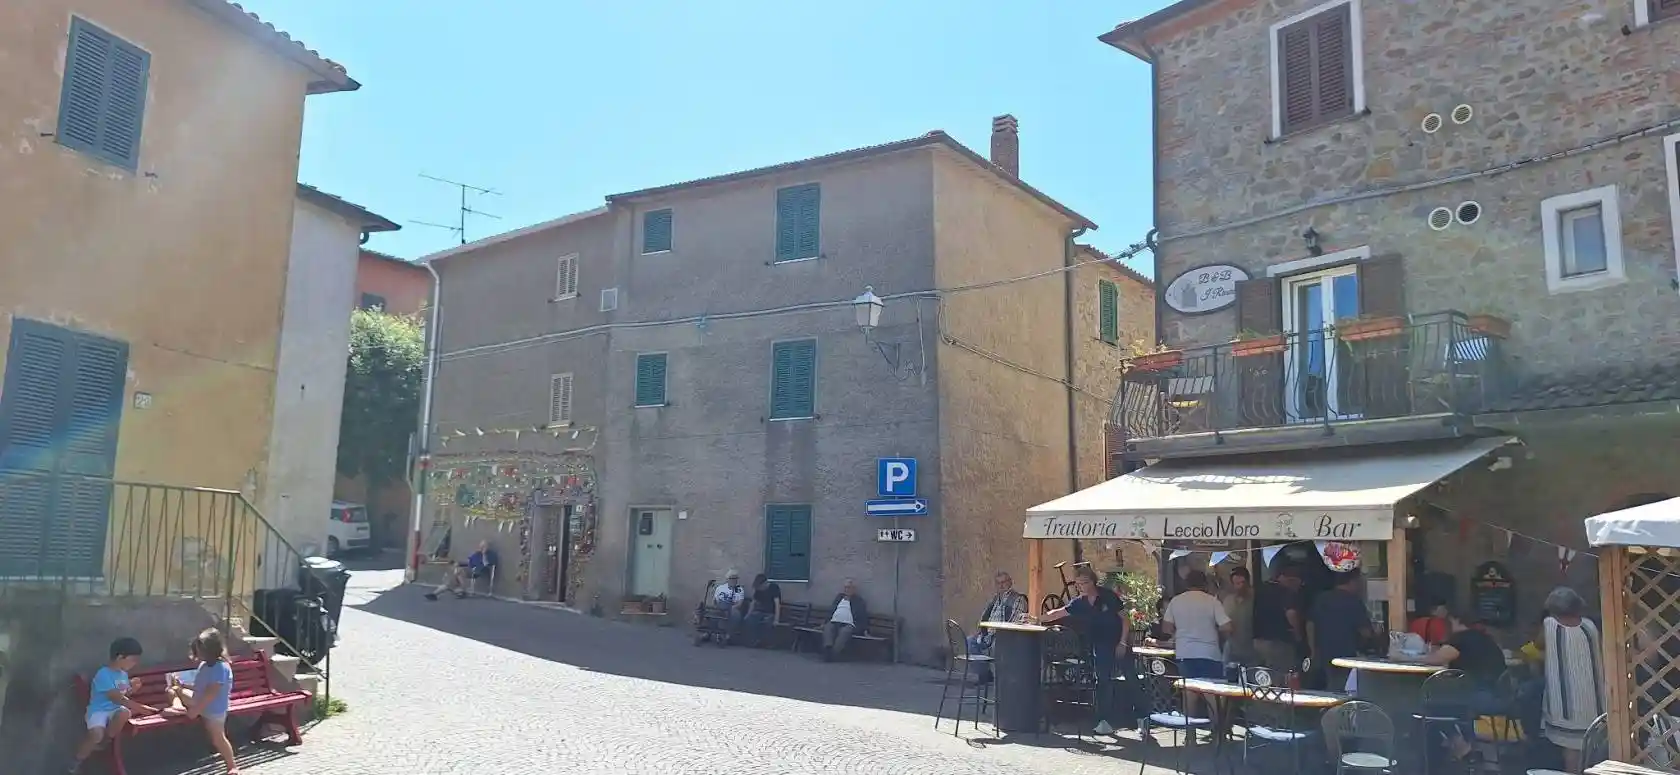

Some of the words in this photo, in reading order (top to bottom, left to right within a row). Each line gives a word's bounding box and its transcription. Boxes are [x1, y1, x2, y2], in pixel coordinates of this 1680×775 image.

[886, 462, 909, 492] P
[891, 530, 903, 540] WC
[1044, 516, 1117, 537] Trattoria
[1164, 517, 1213, 537] Leccio
[1216, 515, 1260, 538] Moro
[1314, 513, 1361, 538] Bar
